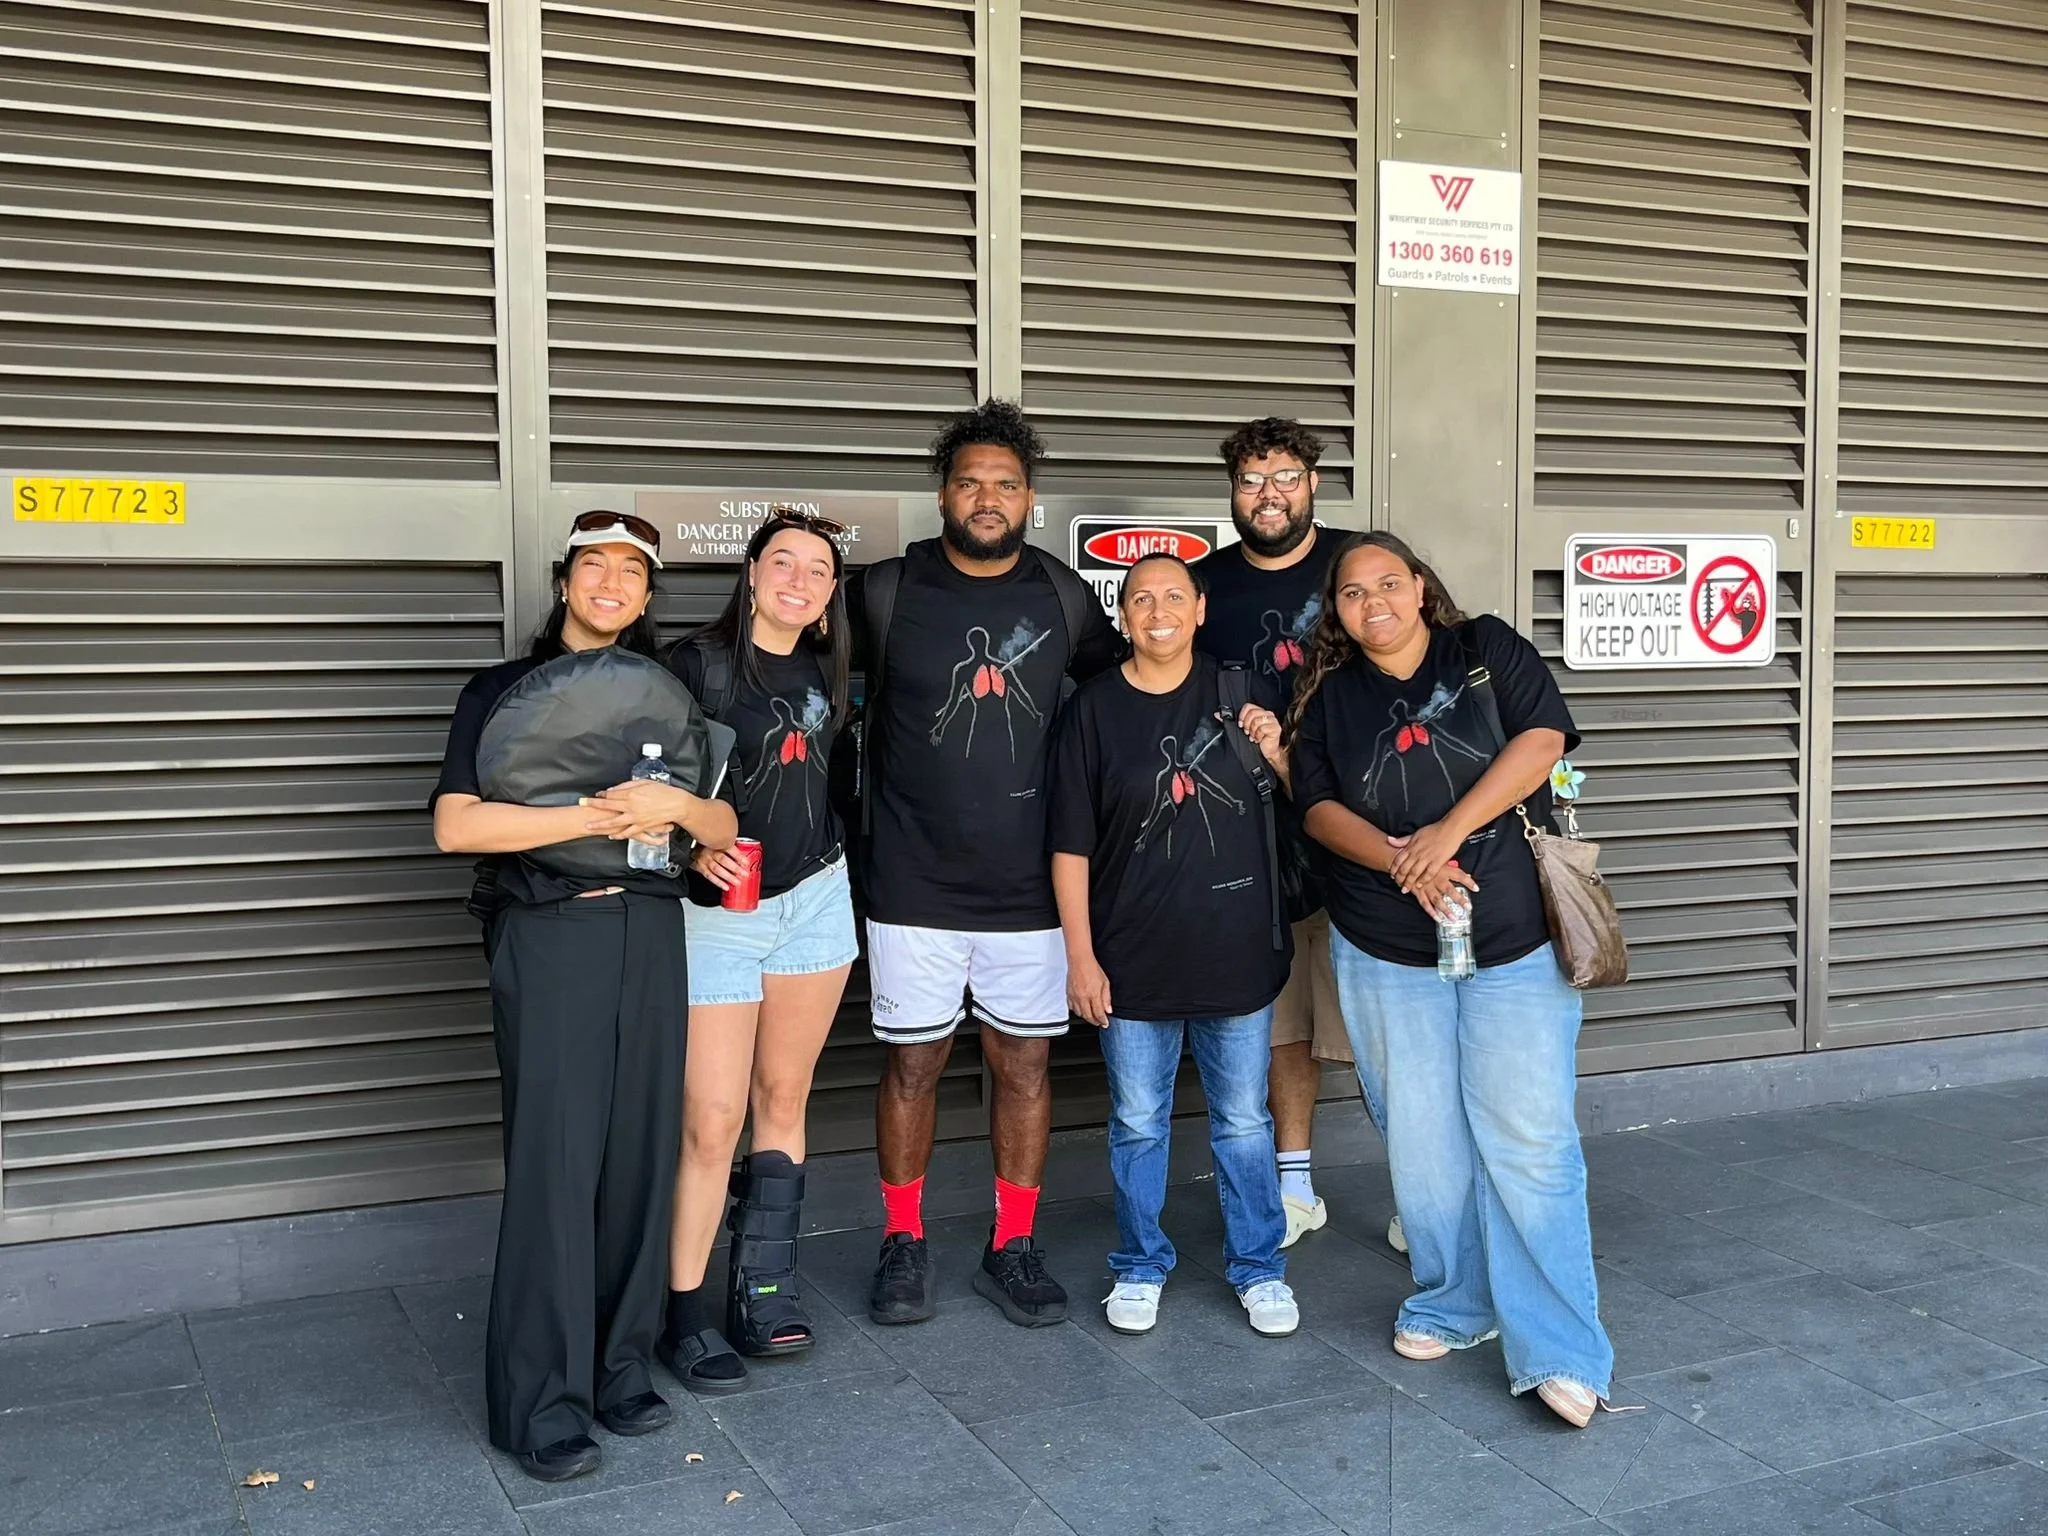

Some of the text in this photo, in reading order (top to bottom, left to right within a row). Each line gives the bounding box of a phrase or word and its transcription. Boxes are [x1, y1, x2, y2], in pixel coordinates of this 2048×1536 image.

[1428, 217, 1458, 227] SECURITY
[1460, 220, 1488, 230] SERVICES
[1490, 222, 1501, 231] PTY
[1503, 223, 1513, 232] LTD
[1388, 240, 1513, 267] 1300 360 619
[1388, 267, 1513, 286] Guards Patrols Events
[19, 486, 179, 515] S77723
[677, 523, 743, 540] DANGER
[1853, 522, 1930, 543] S77722
[689, 542, 749, 555] AUTHORIS
[1117, 535, 1179, 559] DANGER
[1591, 555, 1671, 575] DANGER
[1579, 592, 1682, 618] HIGH VOLTAGE
[1579, 624, 1682, 658] KEEP OUT
